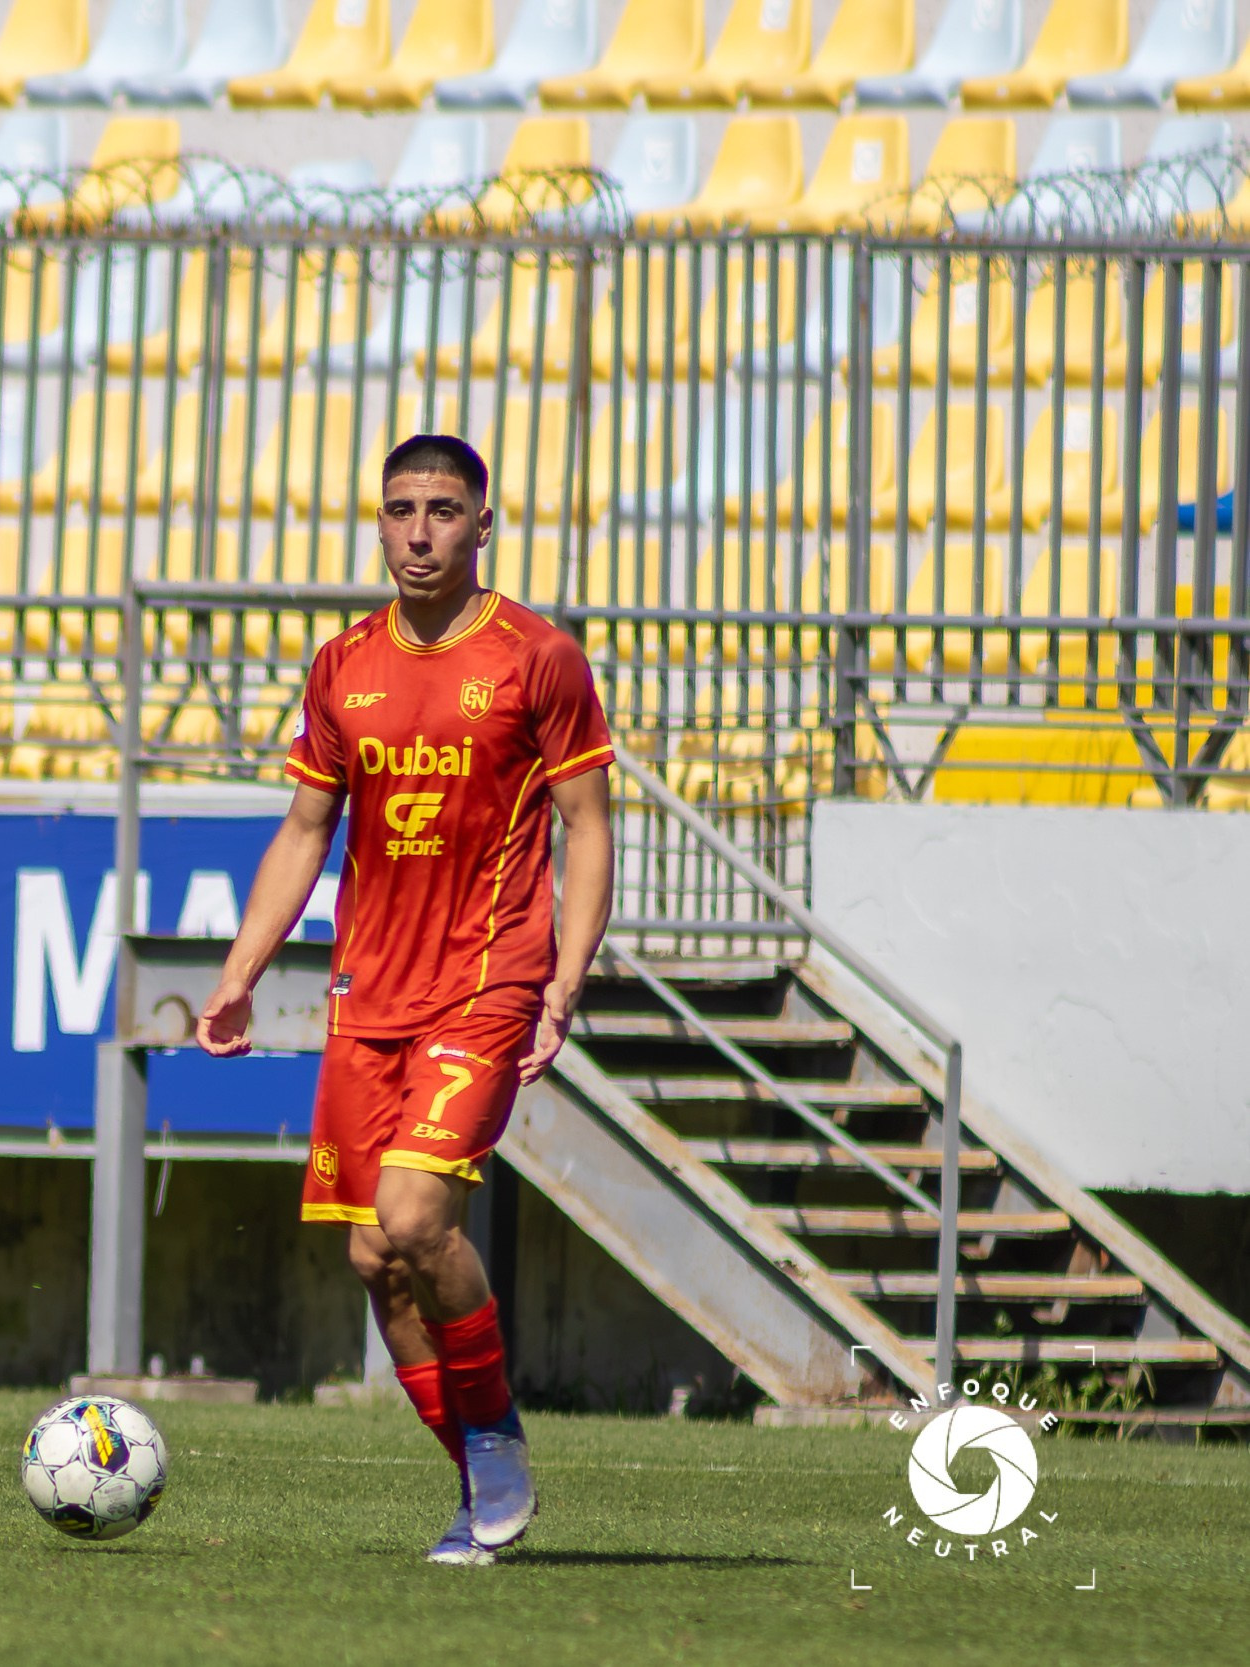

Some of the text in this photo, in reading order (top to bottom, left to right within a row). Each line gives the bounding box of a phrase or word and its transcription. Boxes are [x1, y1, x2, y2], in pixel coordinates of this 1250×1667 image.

[358, 735, 473, 777] Dubai
[385, 834, 445, 861] sport
[427, 1062, 474, 1123] 7
